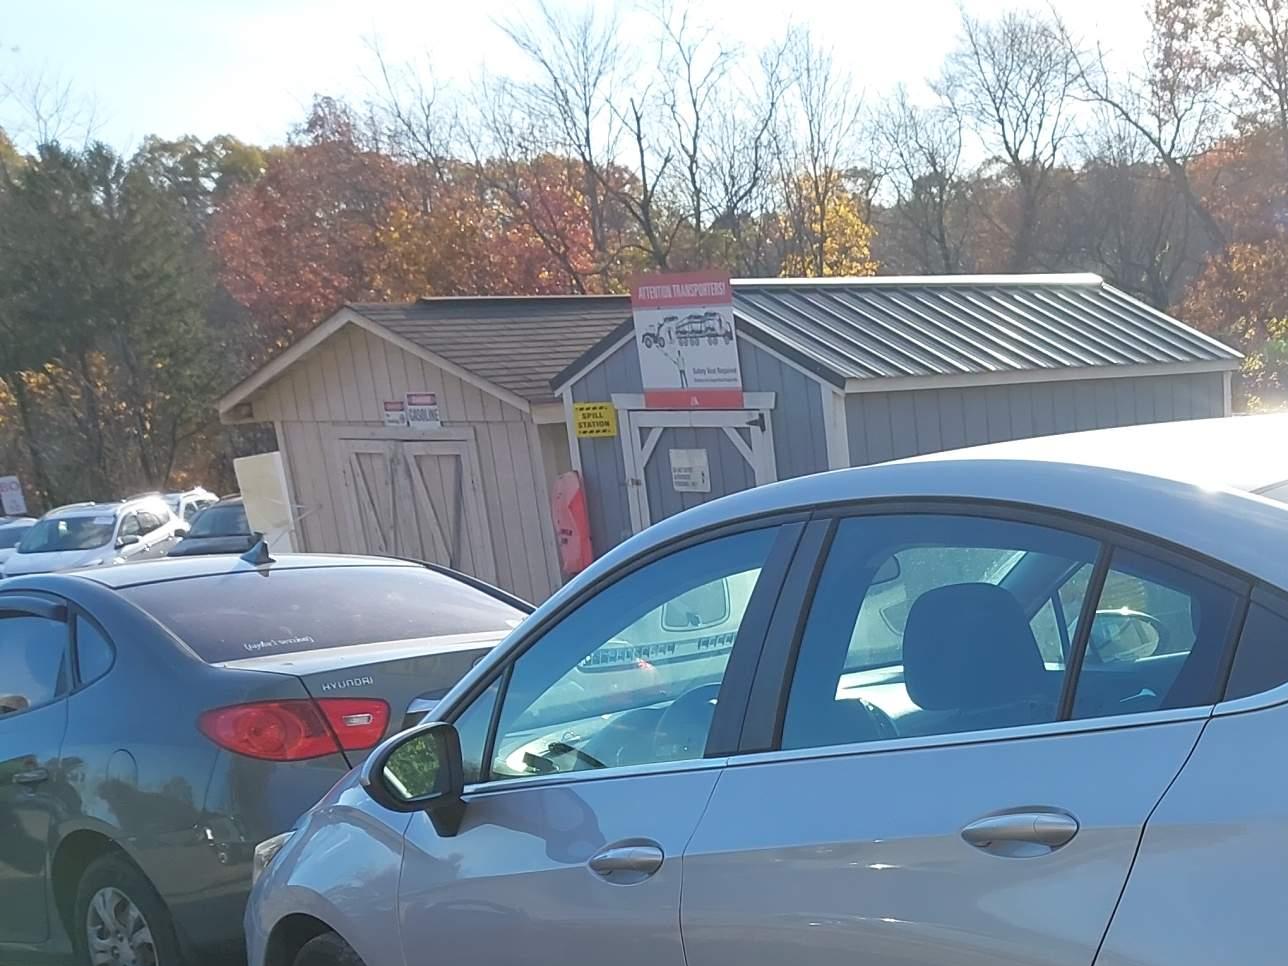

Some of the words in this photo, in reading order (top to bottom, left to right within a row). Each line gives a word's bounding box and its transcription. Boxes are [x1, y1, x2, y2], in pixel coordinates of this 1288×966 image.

[638, 285, 672, 300] ATTENTION
[672, 281, 726, 298] TRANSPORTERS!
[409, 407, 439, 421] GASOLINE
[578, 420, 610, 429] STATION
[321, 675, 374, 692] HYUNDAI
